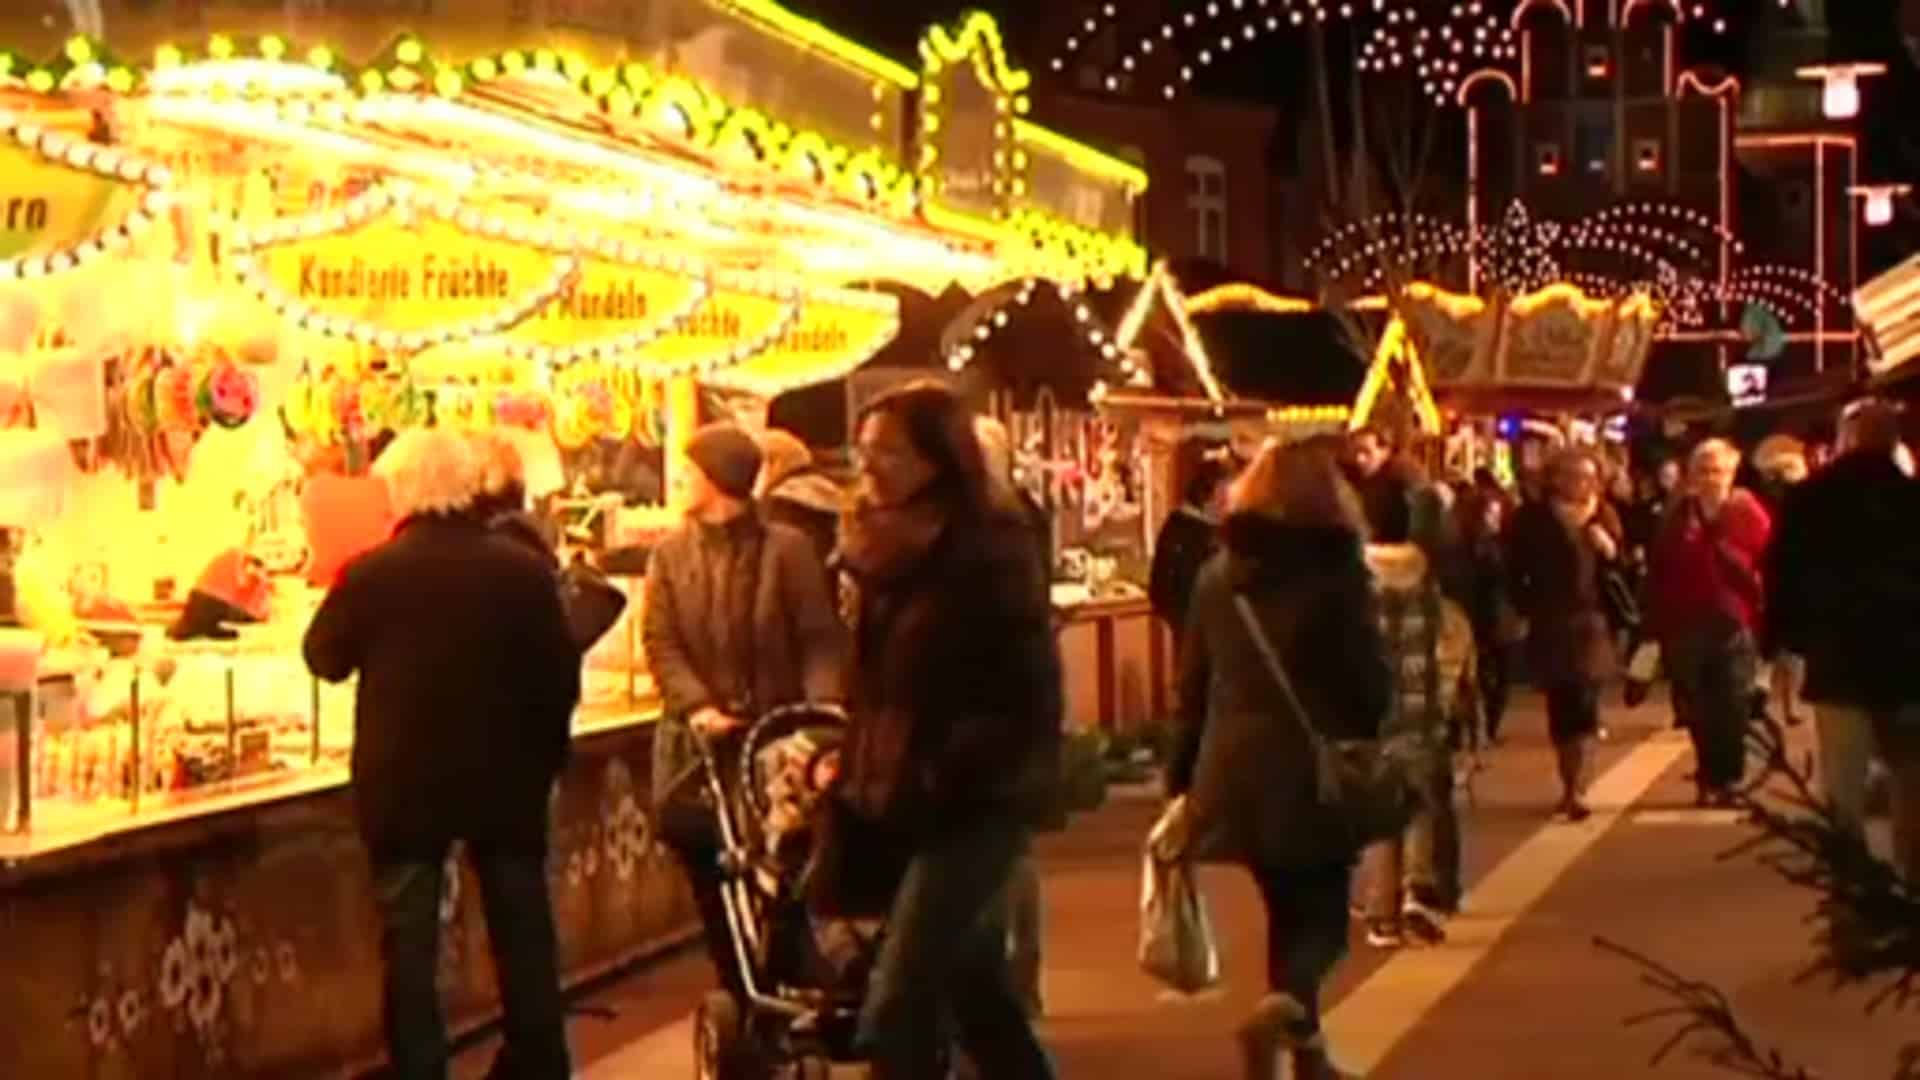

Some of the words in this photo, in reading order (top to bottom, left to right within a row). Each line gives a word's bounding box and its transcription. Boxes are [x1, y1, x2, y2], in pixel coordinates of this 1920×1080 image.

[4, 196, 48, 232] rn
[299, 253, 409, 300] Kandierte
[421, 252, 508, 300] Früchte
